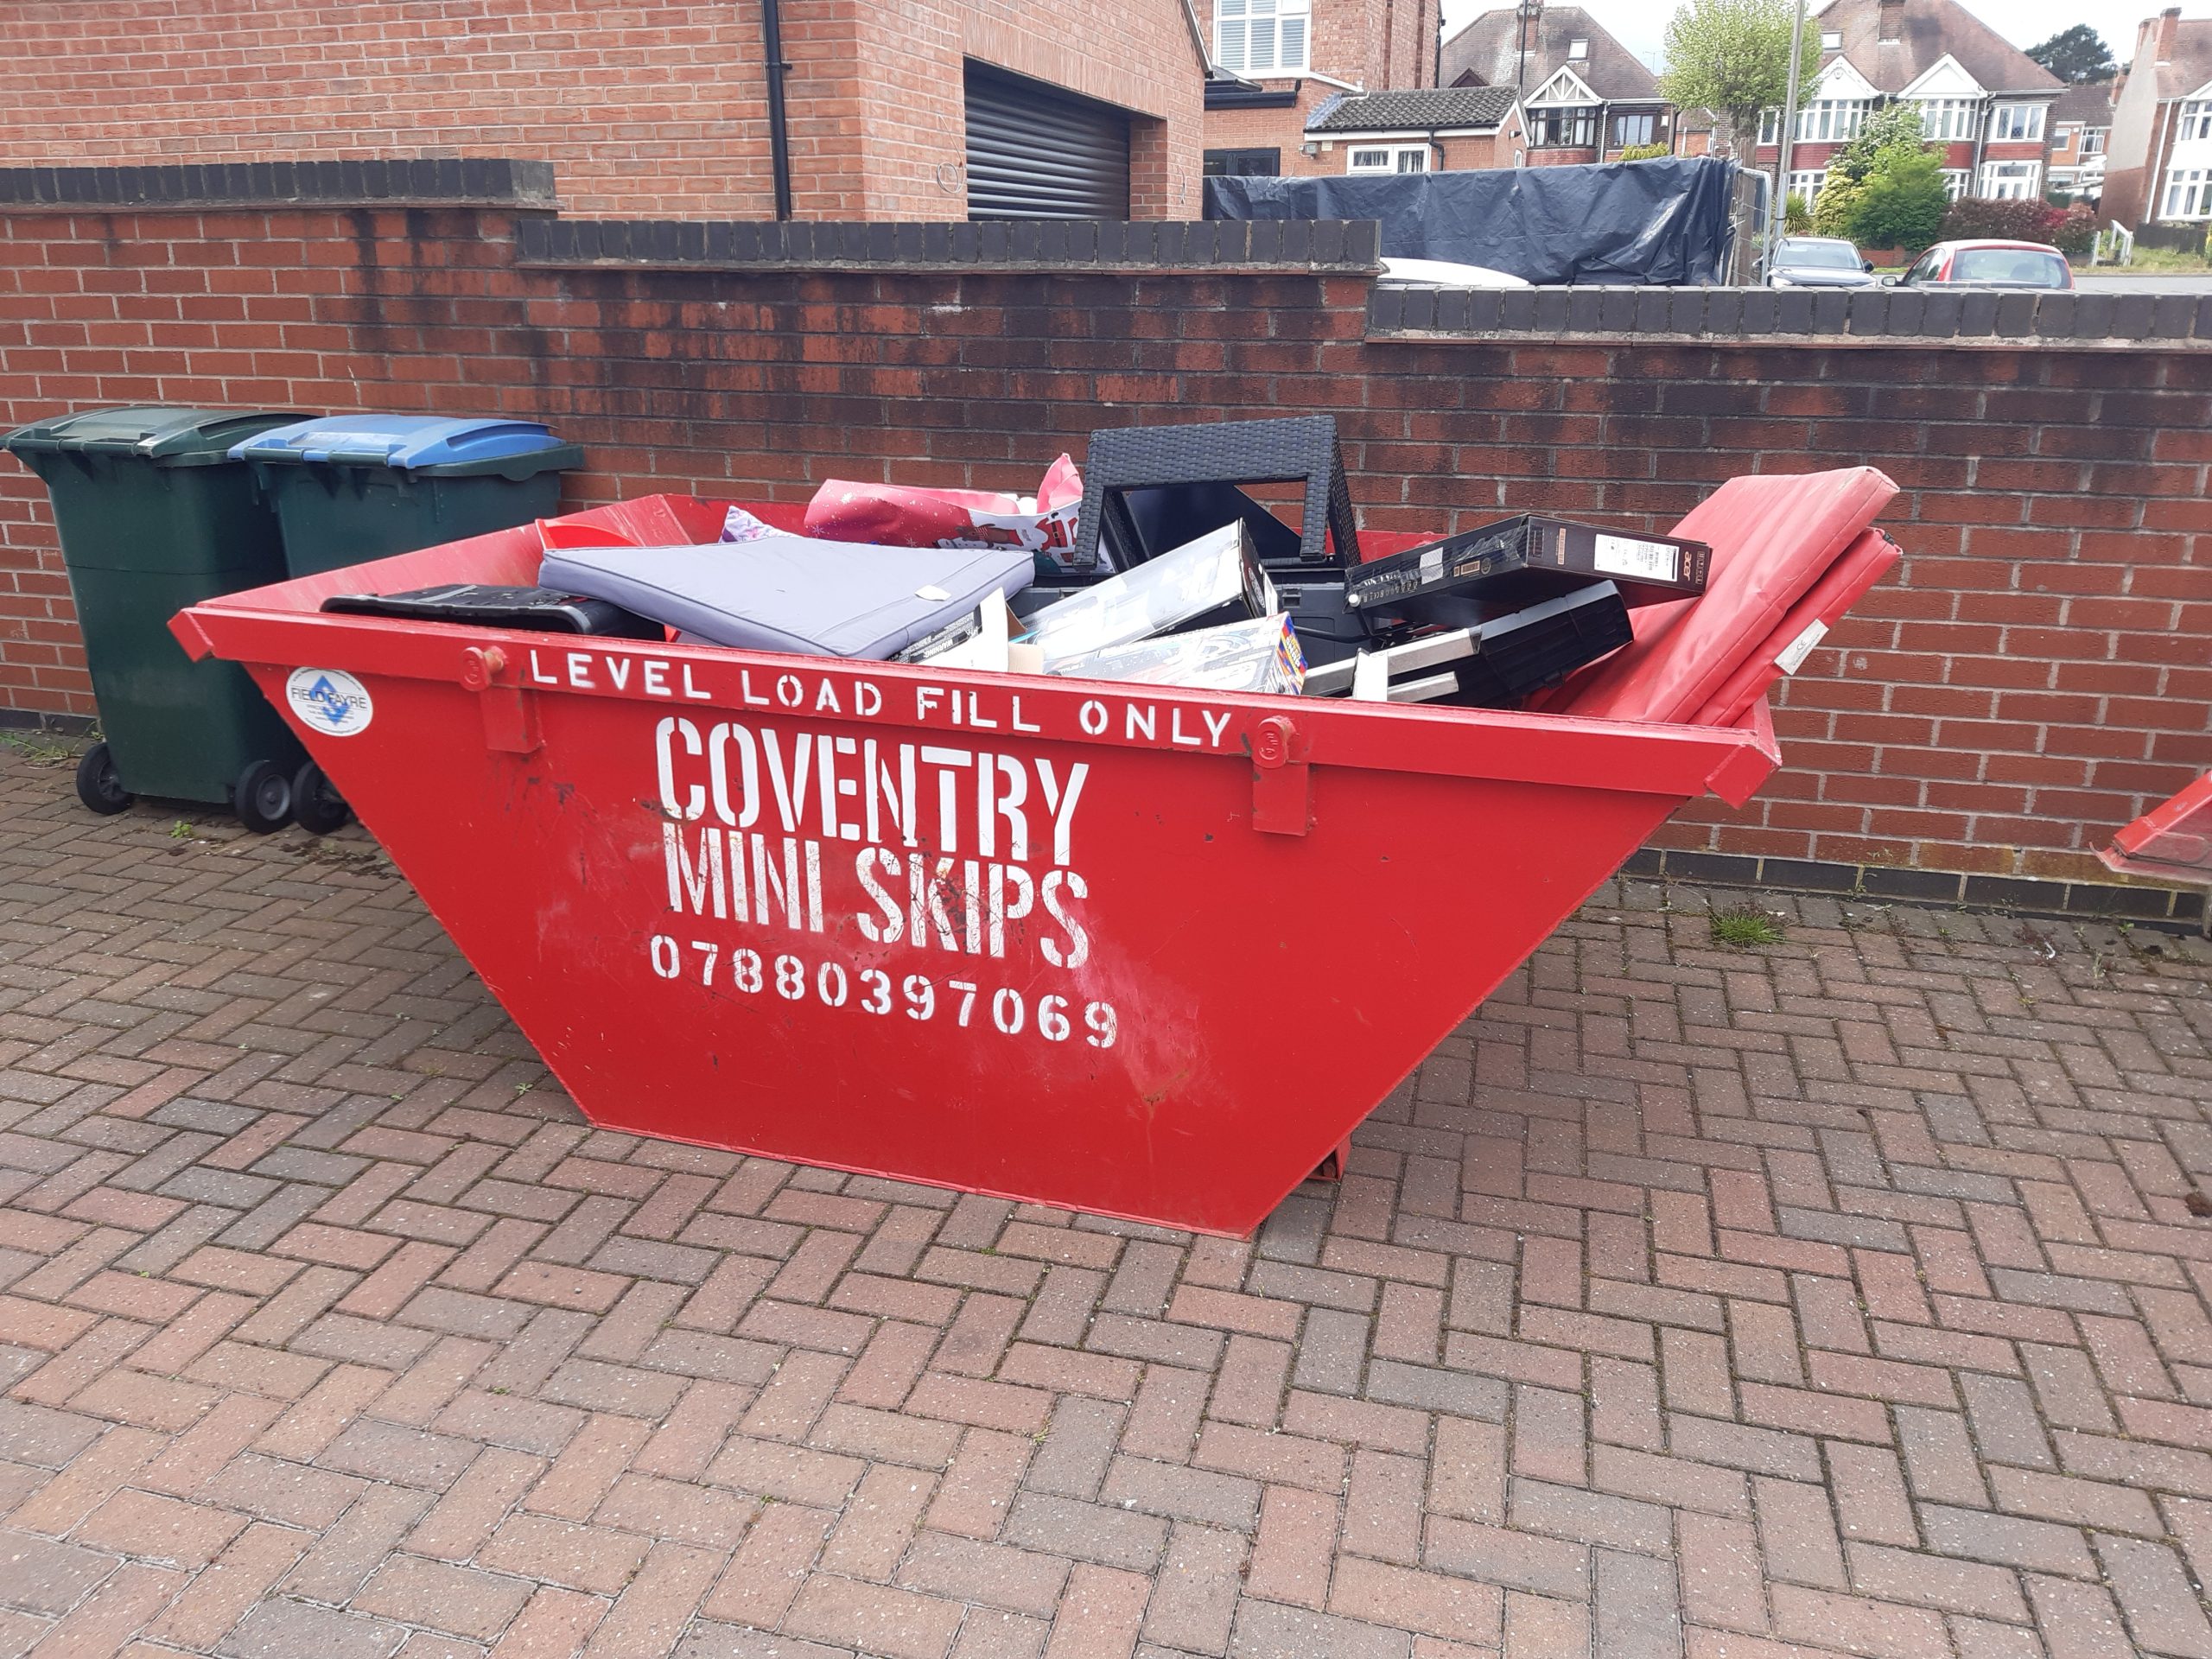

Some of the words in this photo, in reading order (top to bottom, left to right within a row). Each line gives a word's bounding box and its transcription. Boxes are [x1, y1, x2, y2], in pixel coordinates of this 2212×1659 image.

[1683, 551, 1692, 582] acer
[290, 687, 326, 702] FIELD
[327, 692, 367, 709] FAYRE
[530, 649, 712, 700] LEVEL
[741, 670, 882, 716] LOAD
[916, 686, 1041, 733] FILL
[1078, 699, 1232, 747] ONLY
[655, 716, 1090, 867] COVENTRY
[662, 821, 824, 934] MINI
[855, 847, 1089, 969] SKIPS
[650, 934, 1118, 1049] 07880397069
